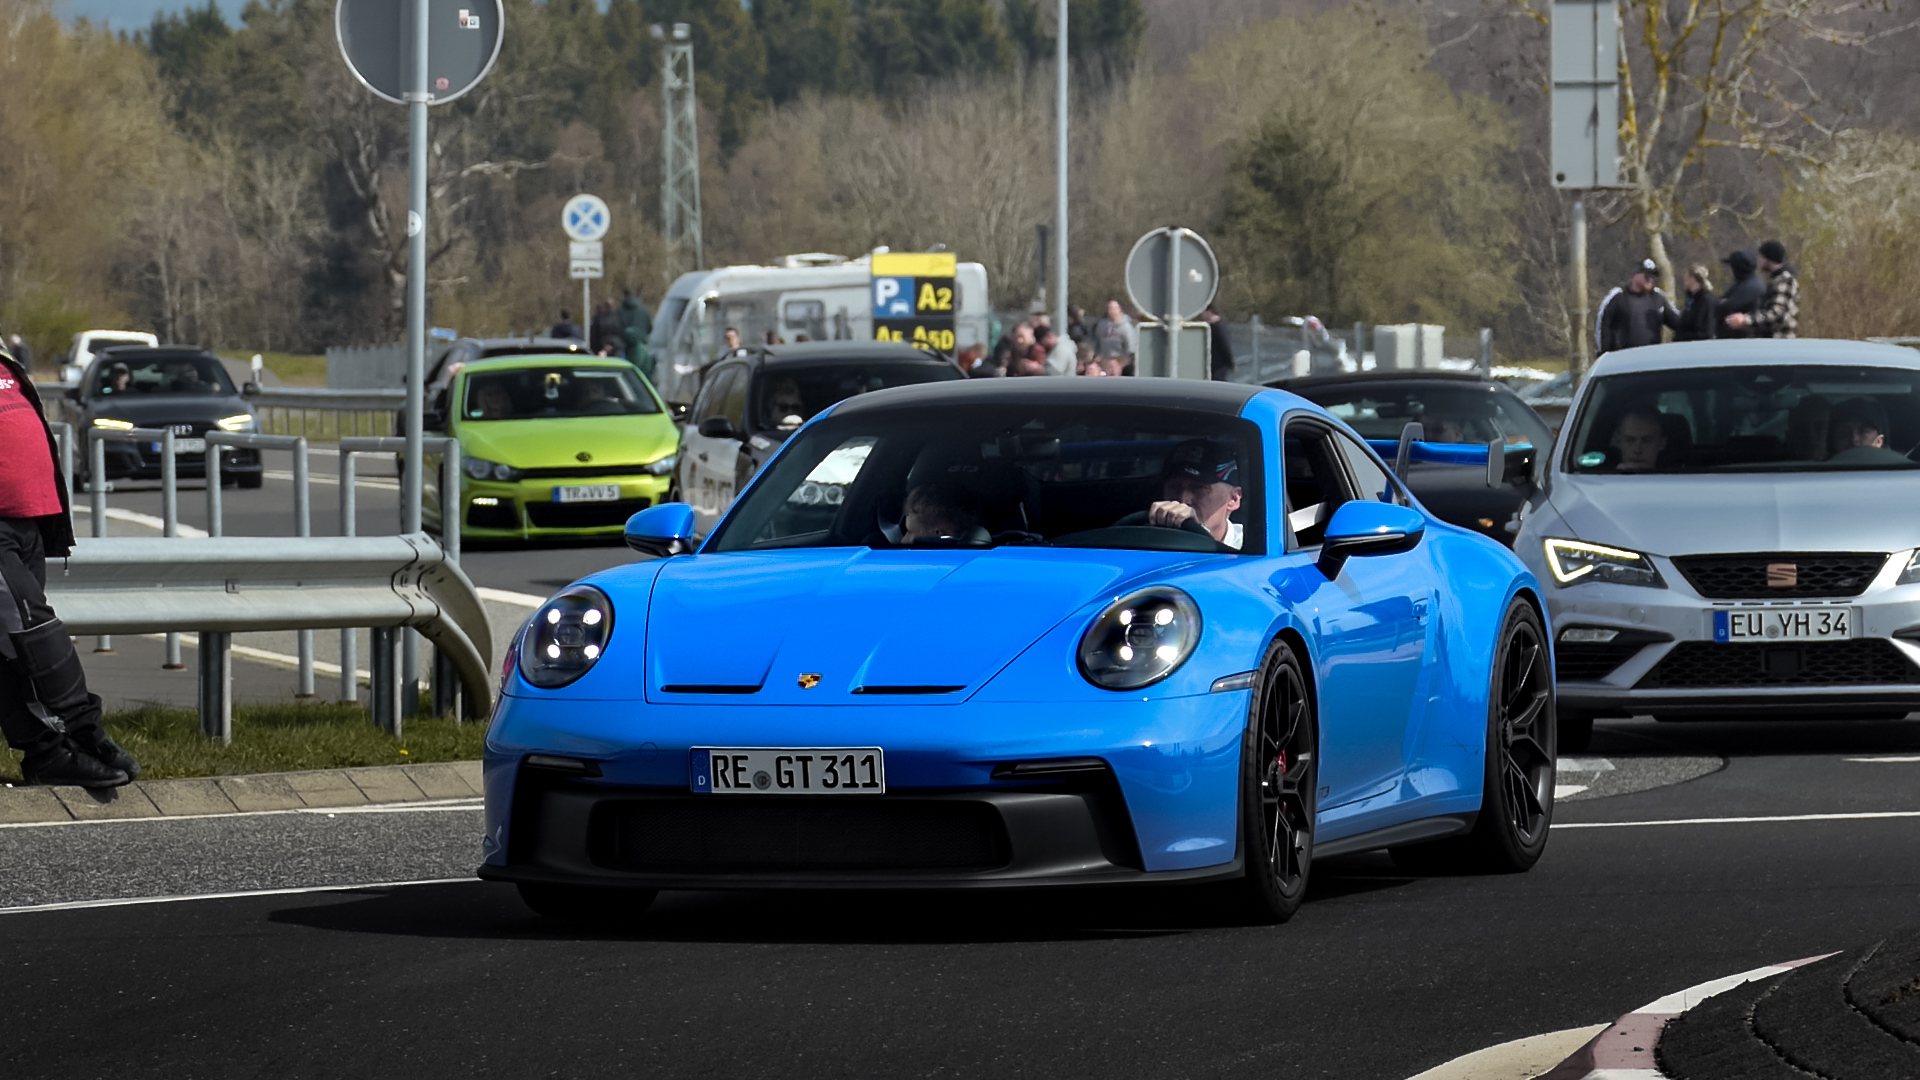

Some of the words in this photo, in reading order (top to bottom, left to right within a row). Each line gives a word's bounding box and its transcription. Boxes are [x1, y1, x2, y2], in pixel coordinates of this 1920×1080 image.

[877, 278, 900, 307] P
[917, 282, 953, 311] A2
[1731, 613, 1763, 637] EU
[1778, 612, 1811, 637] YH
[1817, 612, 1848, 636] 34
[697, 775, 706, 786] D
[711, 755, 752, 789] RE
[775, 755, 814, 789] GT
[820, 754, 880, 789] 311
